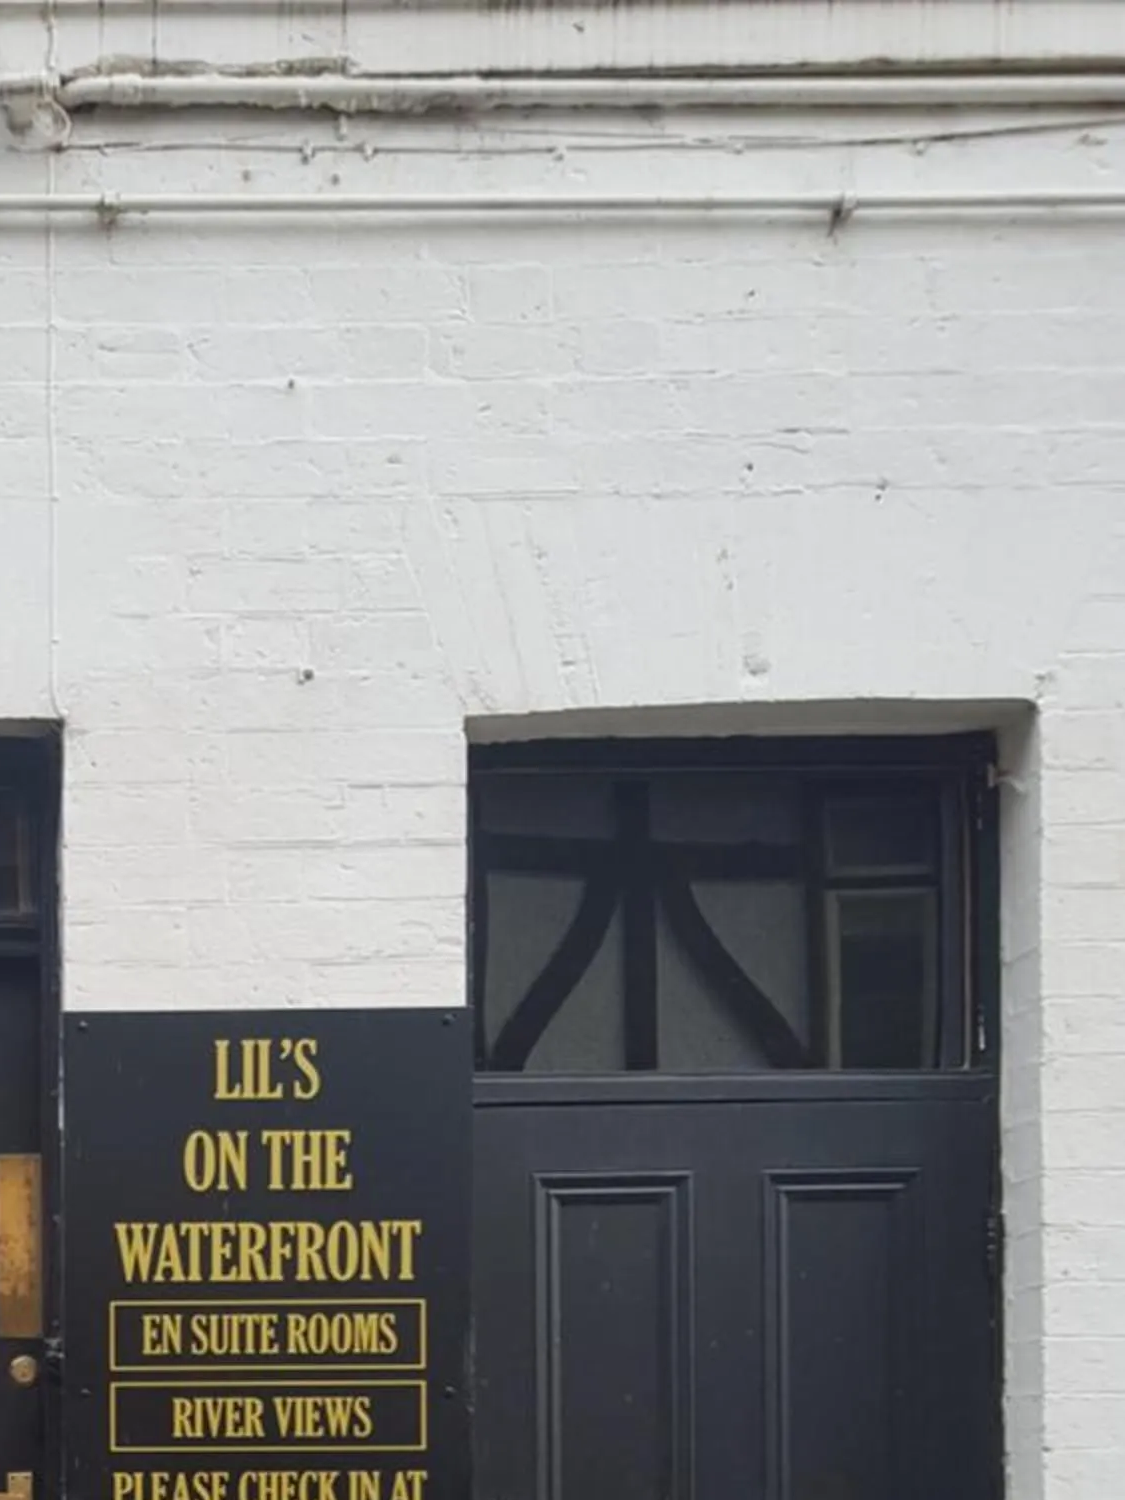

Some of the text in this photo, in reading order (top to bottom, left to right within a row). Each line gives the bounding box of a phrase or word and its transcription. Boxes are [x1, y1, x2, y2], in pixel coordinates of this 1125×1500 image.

[213, 1037, 321, 1100] LIL'S
[183, 1129, 353, 1192] ON THE
[113, 1219, 422, 1283] WATERFRONT
[142, 1312, 398, 1356] EN SUITE ROOMS
[172, 1396, 373, 1438] RIVER VIEWS
